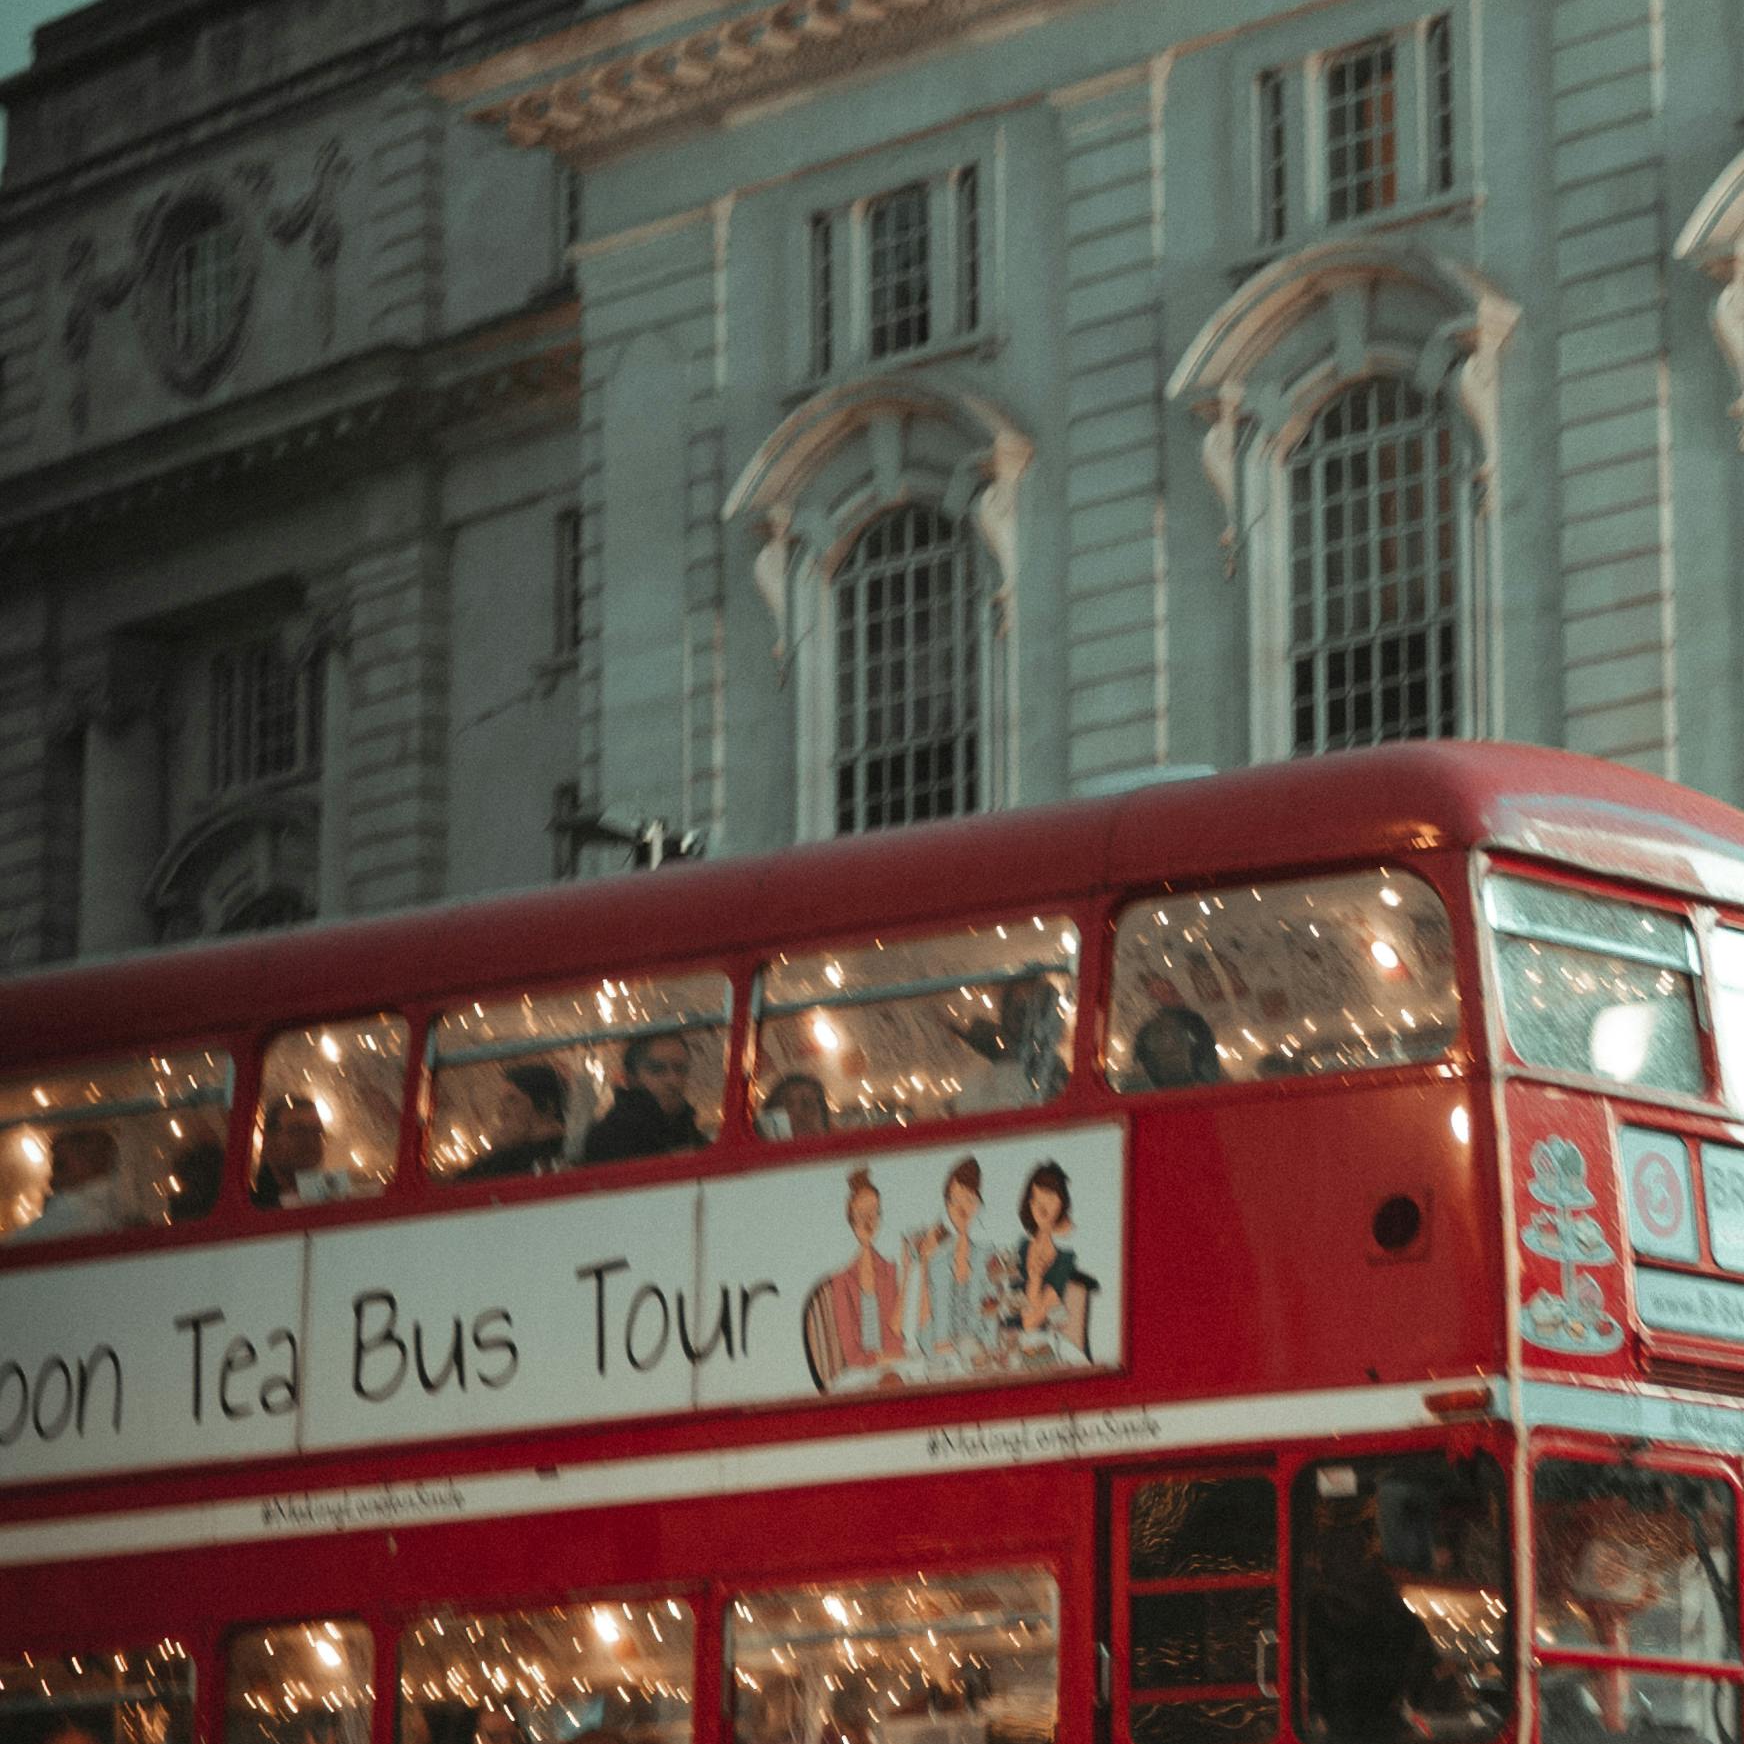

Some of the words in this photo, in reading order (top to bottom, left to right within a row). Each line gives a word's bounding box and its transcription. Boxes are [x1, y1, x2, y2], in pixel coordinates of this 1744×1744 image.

[174, 1306, 300, 1423] Tea
[352, 1289, 518, 1402] Bus
[576, 1256, 780, 1377] Tour
